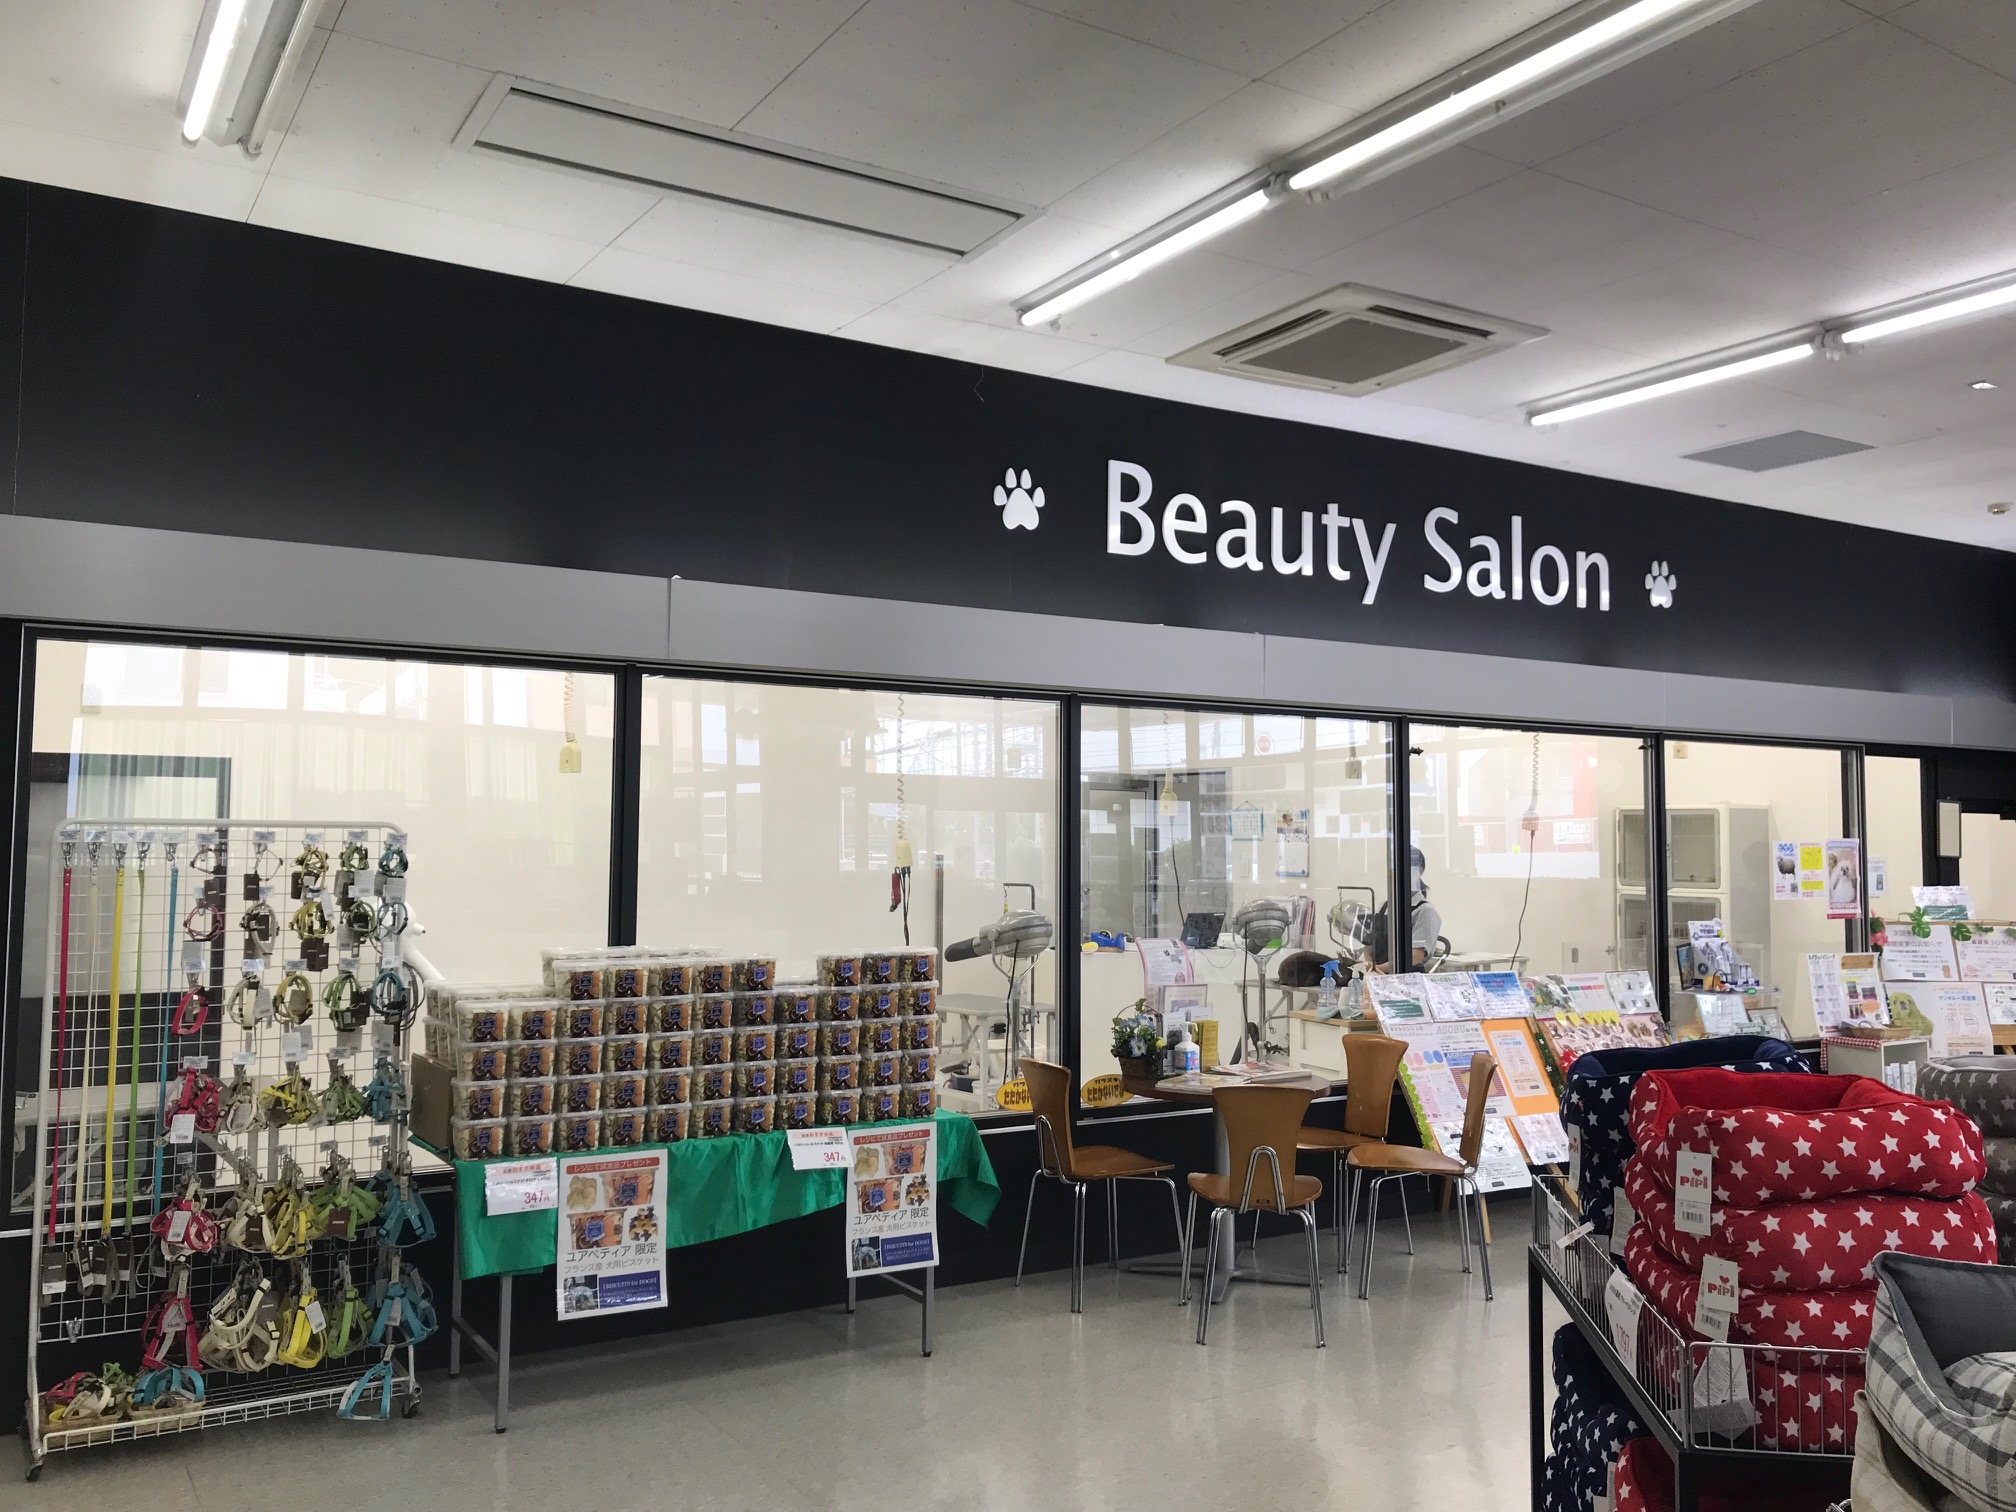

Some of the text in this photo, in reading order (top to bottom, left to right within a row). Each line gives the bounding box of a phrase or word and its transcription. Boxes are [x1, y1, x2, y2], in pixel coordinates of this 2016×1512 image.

[1106, 459, 1611, 612] Beauty Salon
[1436, 1024, 1465, 1034] ASOBU
[910, 1207, 930, 1218] 限定
[886, 1220, 931, 1232] 犬用ビスケット
[635, 1242, 658, 1255] 限定
[605, 1256, 659, 1270] 犬用ビスケット
